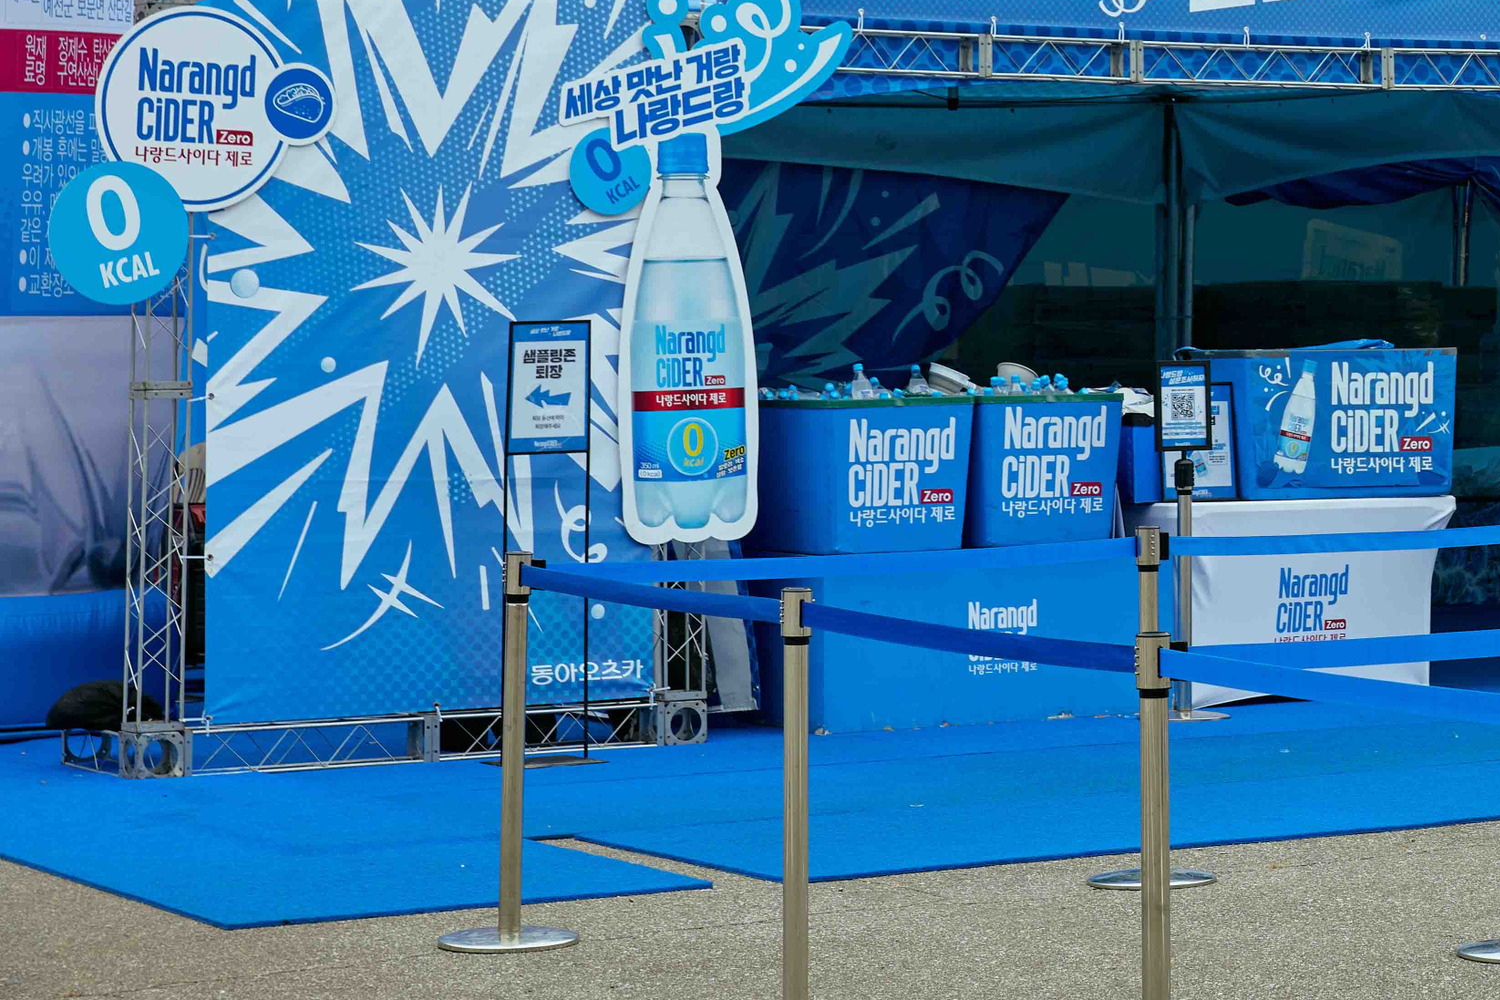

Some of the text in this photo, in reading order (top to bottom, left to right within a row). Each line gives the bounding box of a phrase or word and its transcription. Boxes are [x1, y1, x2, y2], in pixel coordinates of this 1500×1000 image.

[25, 34, 47, 60] 원재
[58, 36, 90, 62] 정제수,
[24, 60, 99, 87] 료명 구연산삼
[138, 47, 257, 109] Narangd
[565, 43, 741, 119] 세상 맛난 거랑
[33, 109, 85, 135] 직사광선을
[615, 76, 745, 145] 나랑드랑
[32, 137, 87, 162] 개봉 후에는
[219, 131, 251, 145] Zero
[135, 146, 253, 167] 나랑드사이다 제로
[585, 138, 622, 182] 0
[22, 163, 54, 188] 우려가
[21, 190, 45, 215] 우유,
[605, 175, 641, 205] KCAL
[87, 174, 141, 250] 0
[20, 218, 41, 243] 같은
[29, 246, 40, 270] 이
[99, 251, 160, 289] KCAL
[523, 348, 577, 364] 샘플링존
[655, 324, 726, 363] Narangd
[535, 364, 562, 379] 퇴장
[707, 377, 725, 385] Zero
[656, 392, 726, 407] 나랑드사이다 제로
[1331, 361, 1434, 417] Narangd
[683, 423, 703, 457] 0
[848, 416, 956, 474] Narangd
[1004, 405, 1107, 461] Narangd
[1403, 438, 1430, 450] Zero
[683, 457, 704, 467] kcal
[724, 445, 745, 460] Zero
[1331, 457, 1433, 475] 나랑드사이다 제로
[923, 491, 952, 503] Zero
[1073, 483, 1100, 496] Zero
[850, 506, 956, 528] 나랑드사이다 제로
[1001, 497, 1104, 519] 나랑드사이다 제로
[1279, 564, 1349, 605] Narangd
[968, 598, 1037, 635] Narangd
[1326, 620, 1345, 629] Zero
[530, 658, 644, 686] 동아오츠카
[969, 661, 1038, 675] 나랑드사이다 제로
